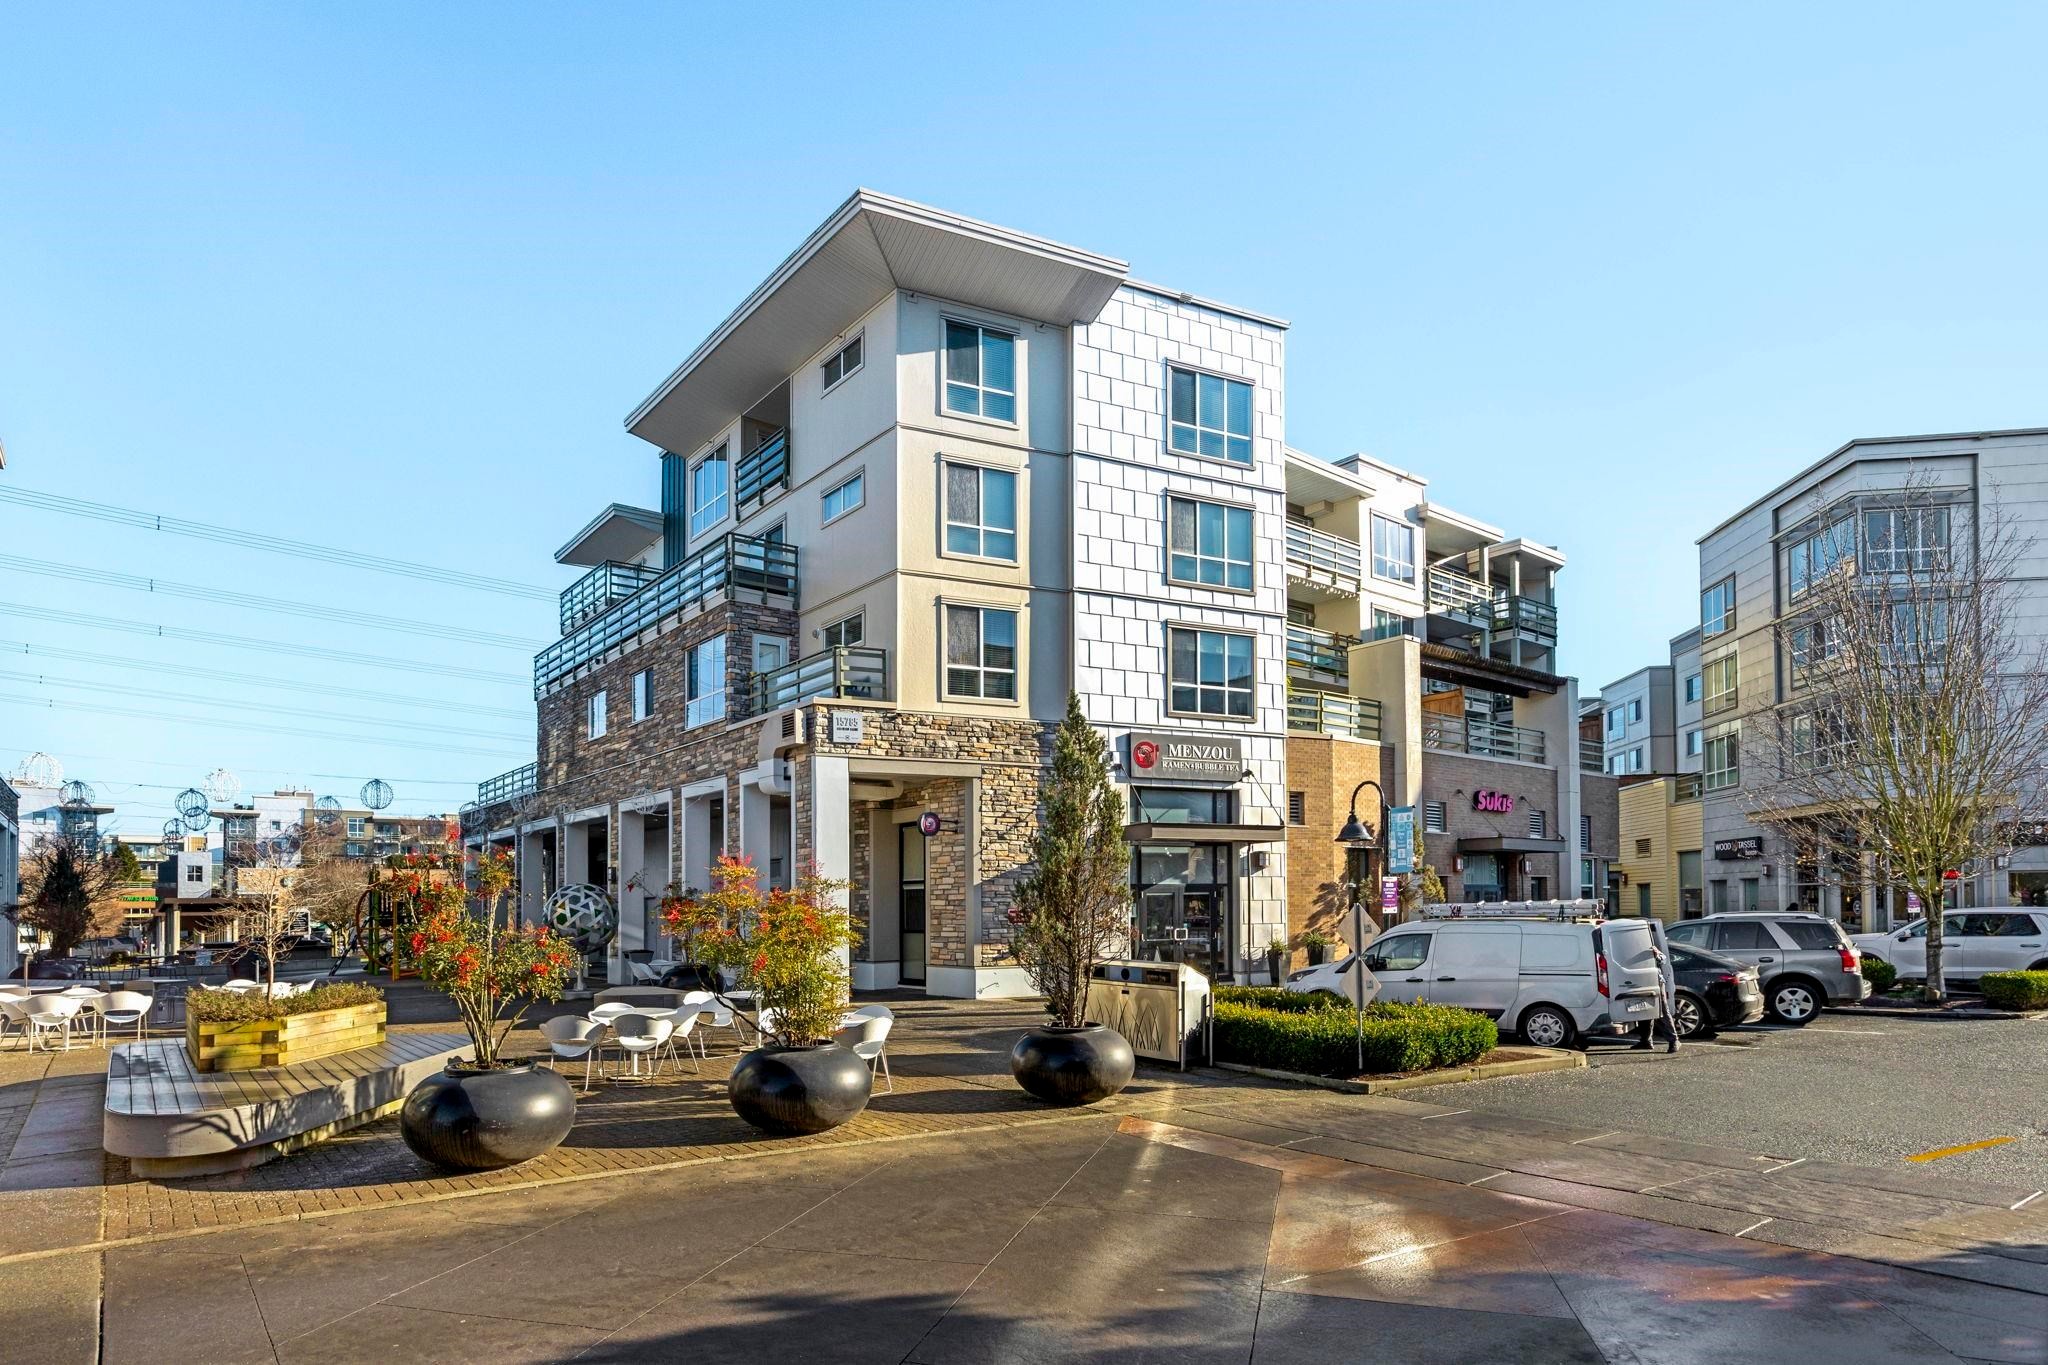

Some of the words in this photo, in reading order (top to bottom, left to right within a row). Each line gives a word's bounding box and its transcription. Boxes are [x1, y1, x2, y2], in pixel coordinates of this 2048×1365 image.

[1168, 743, 1232, 760] MENZOU
[1162, 760, 1190, 769] RAMEN
[1194, 762, 1225, 771] BUBBLE
[1226, 763, 1240, 772] TEA
[1715, 842, 1732, 851] WOOD
[1737, 840, 1757, 849] TASSEL
